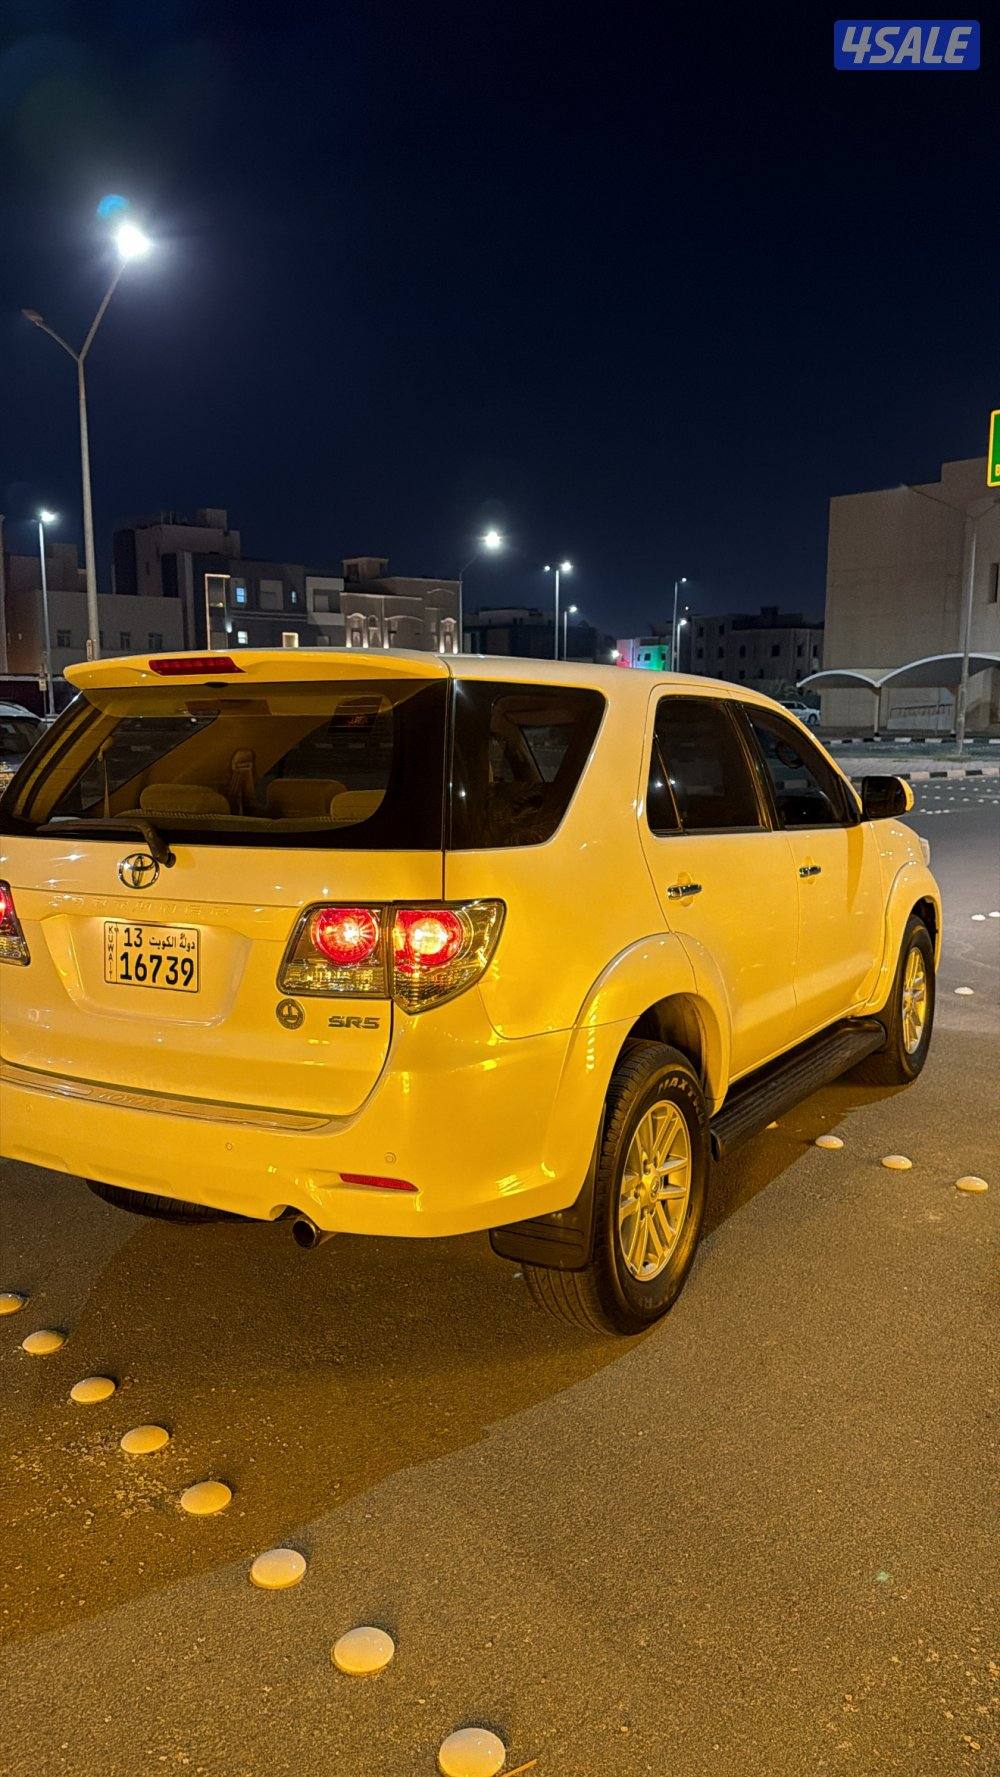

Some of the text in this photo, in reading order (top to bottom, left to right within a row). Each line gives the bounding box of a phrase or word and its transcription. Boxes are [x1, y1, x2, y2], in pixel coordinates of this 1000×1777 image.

[123, 927, 143, 948] 13
[148, 935, 177, 950] الكويت
[107, 925, 115, 980] KUWAIT
[120, 951, 194, 987] 16739
